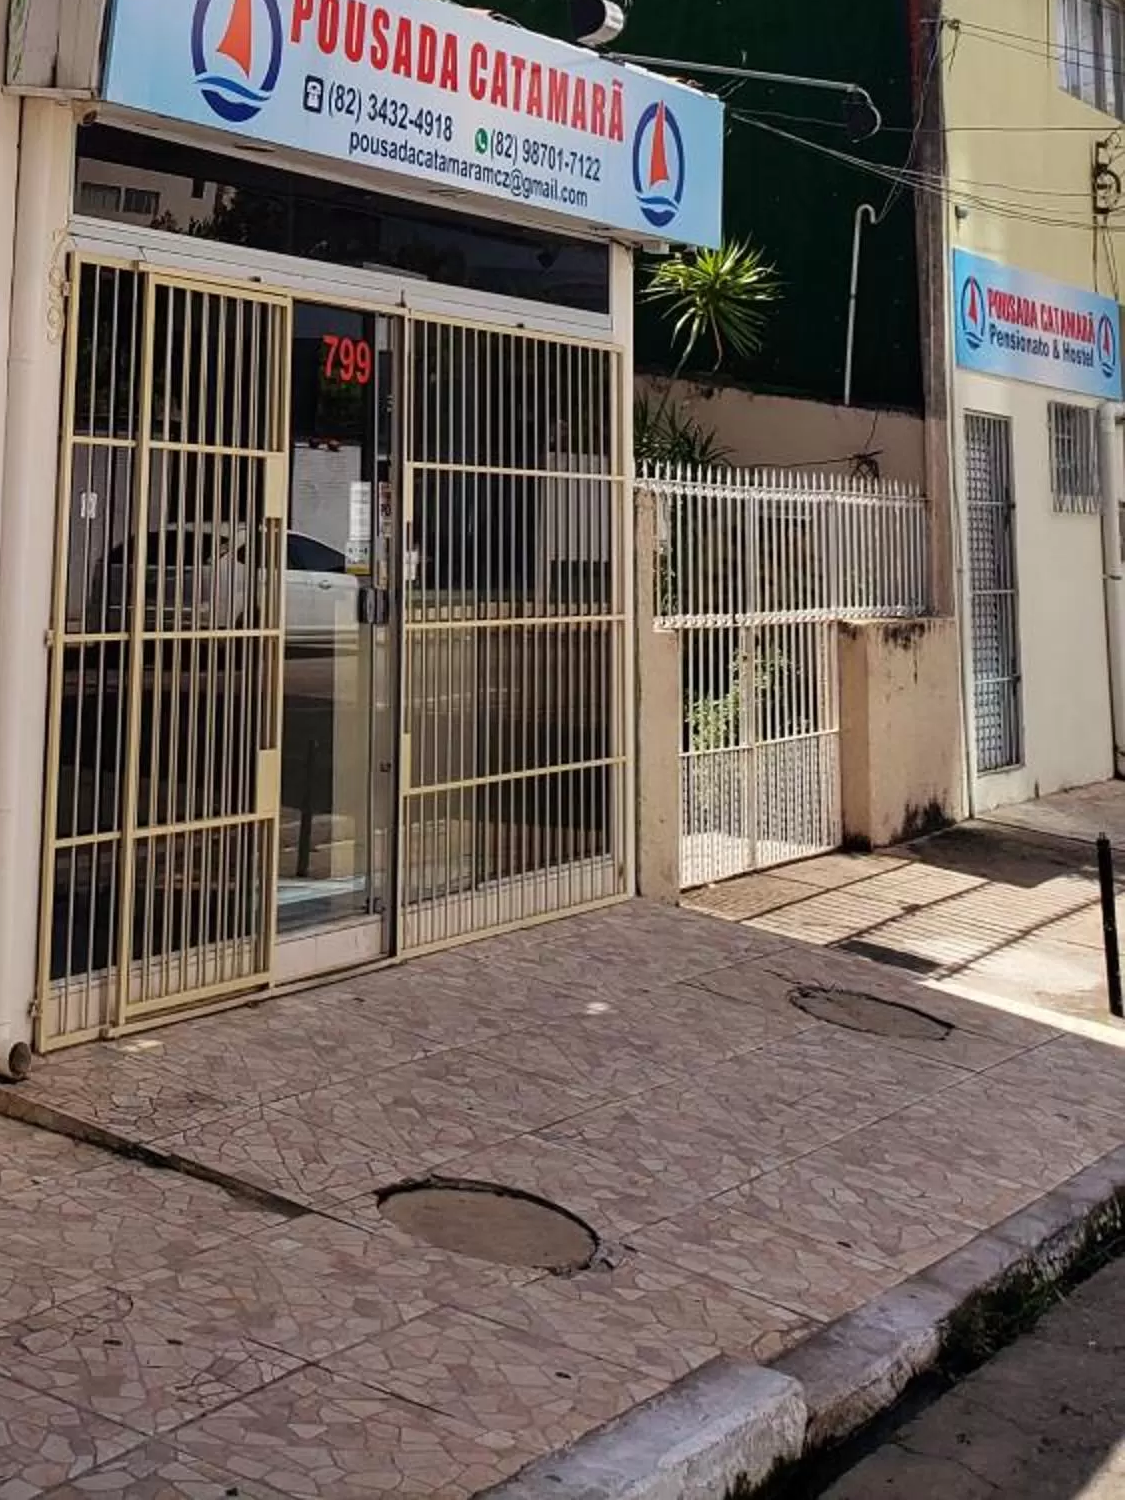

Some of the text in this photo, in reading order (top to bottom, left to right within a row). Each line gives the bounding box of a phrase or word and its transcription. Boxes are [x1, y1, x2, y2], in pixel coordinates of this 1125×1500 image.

[469, 41, 624, 142] CATAMARÃ
[328, 81, 601, 182] (82) 3432-4918 (82) 98701-7122
[349, 131, 588, 207] pousadacatamaramcz@gmail.com
[987, 287, 1096, 345] POUSADA CATAMARÃ
[989, 323, 1095, 368] Pensionato & Hostel
[323, 335, 372, 384] 799
